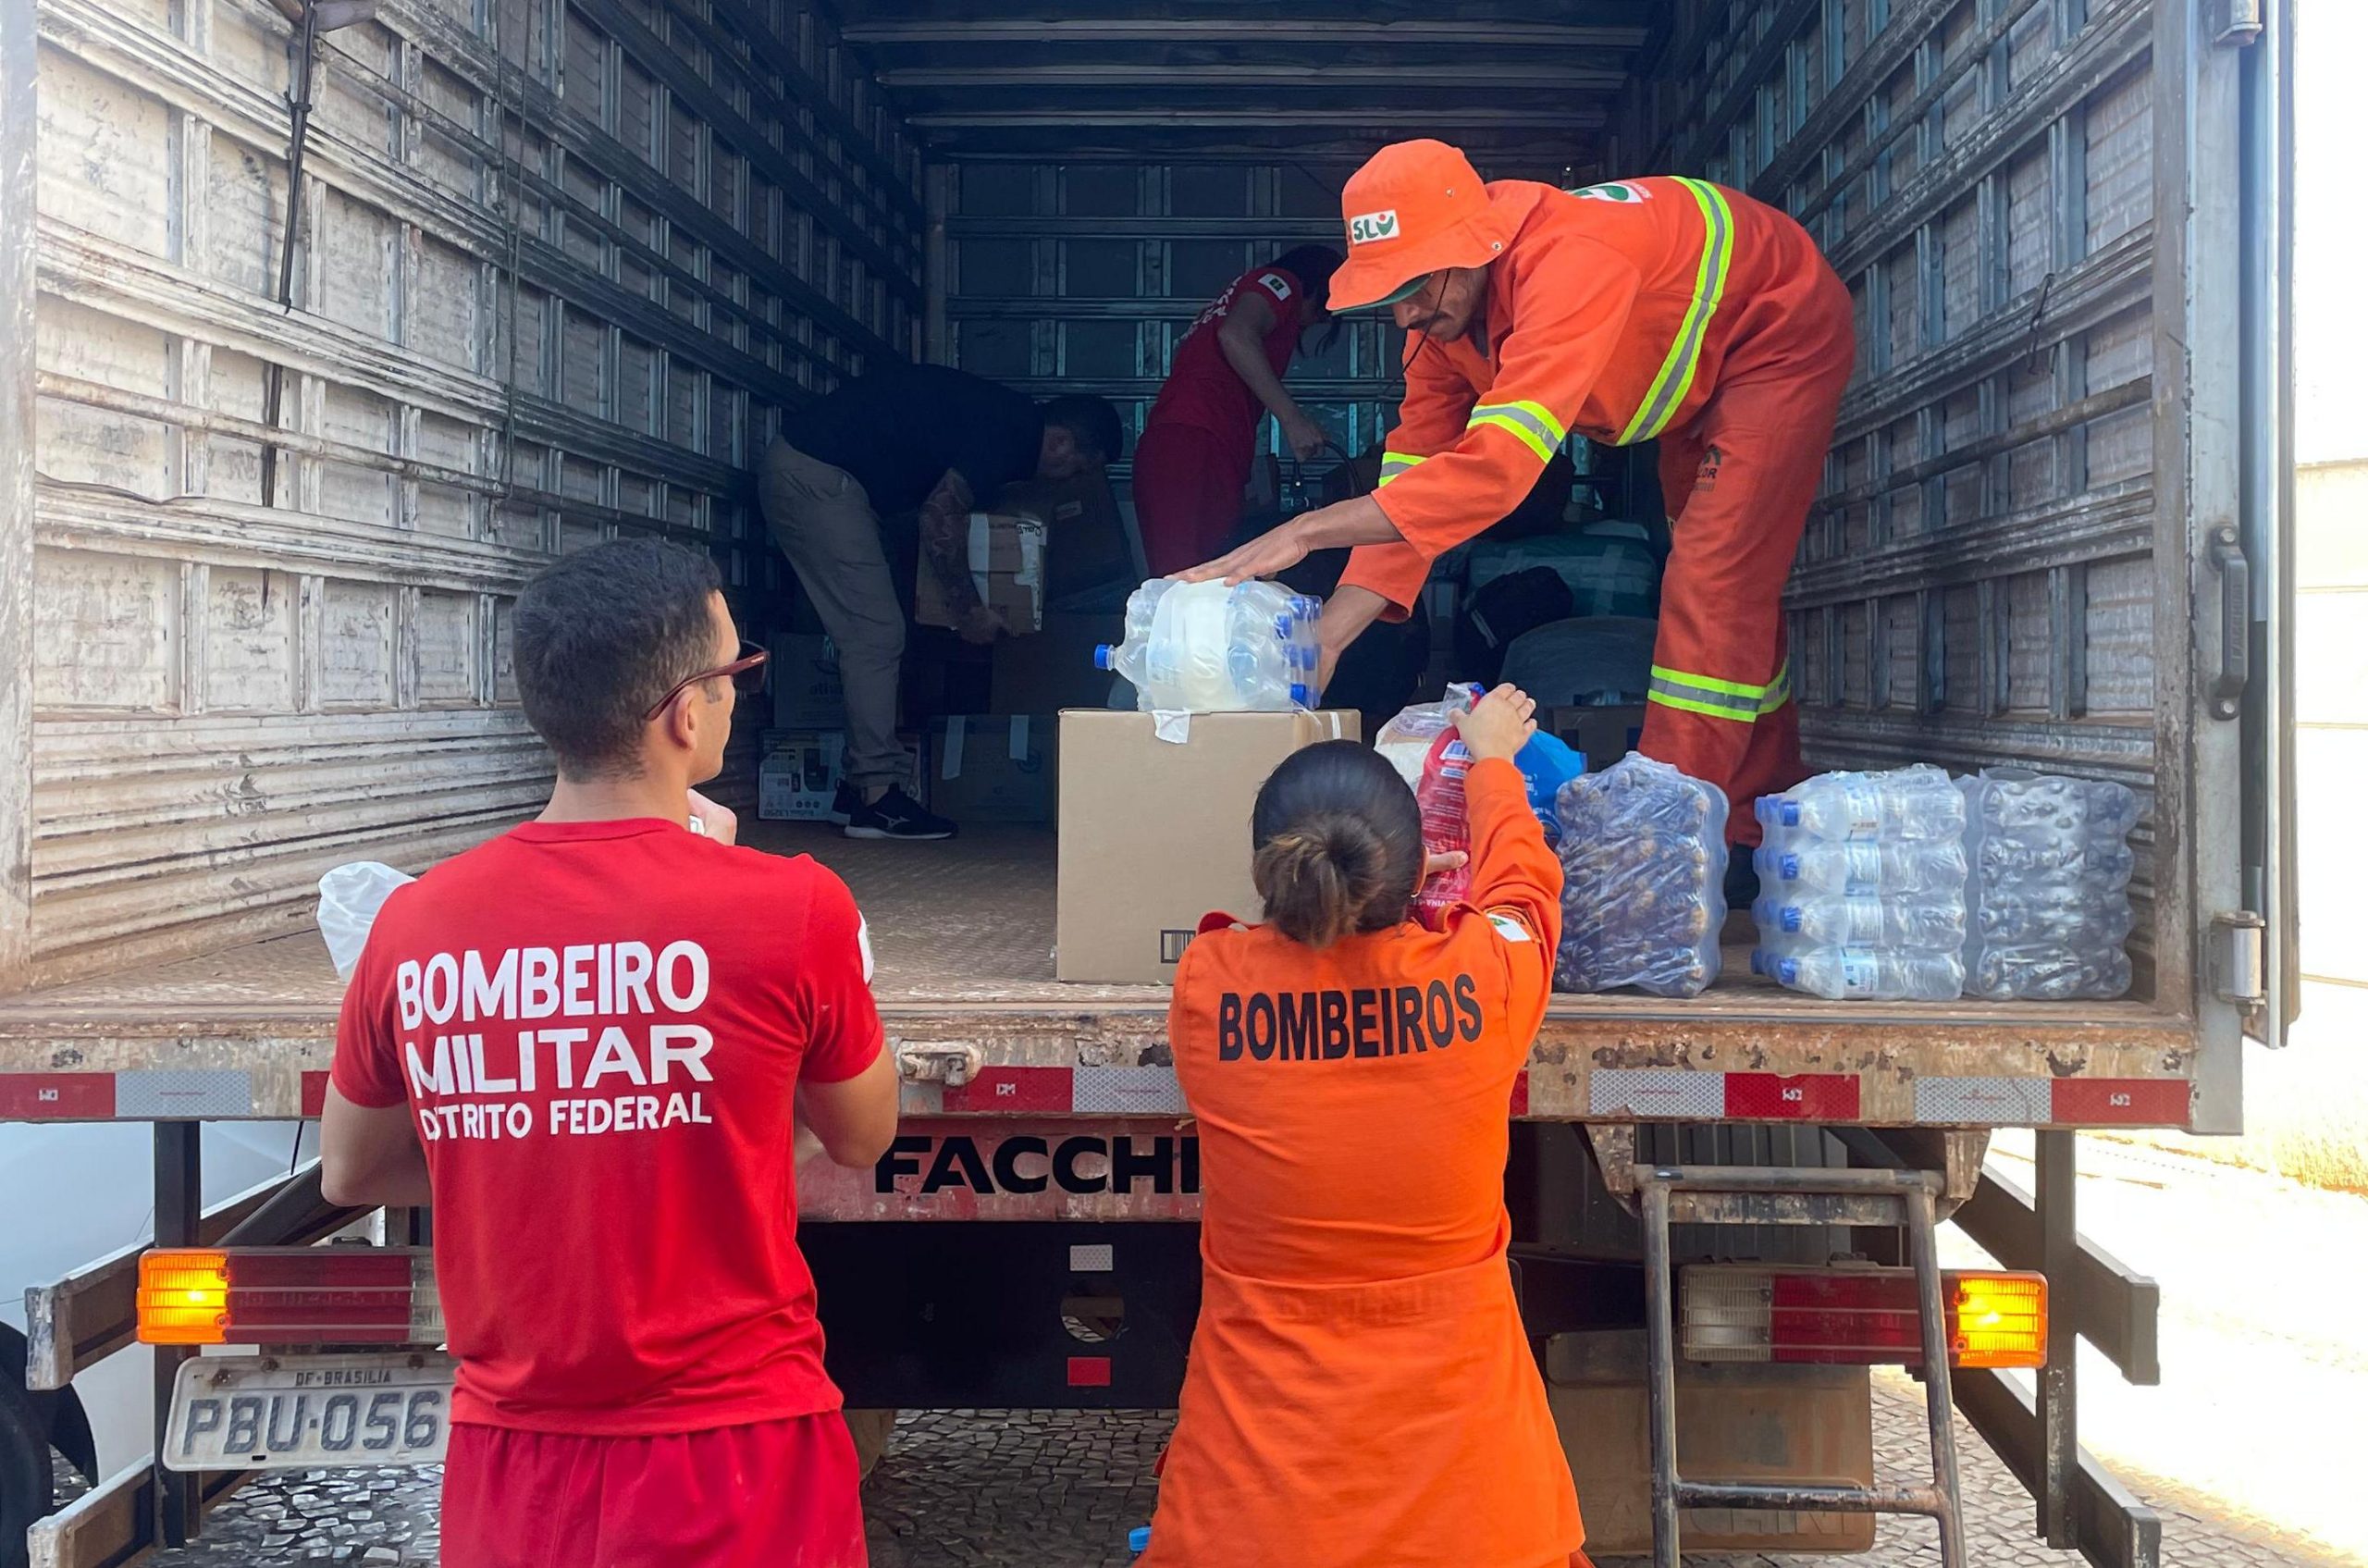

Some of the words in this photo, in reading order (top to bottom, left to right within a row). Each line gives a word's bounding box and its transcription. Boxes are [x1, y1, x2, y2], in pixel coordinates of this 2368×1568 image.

[397, 940, 709, 1031] BOMBEIRO
[1219, 973, 1482, 1061] BOMBEIROS
[405, 1024, 714, 1099] MILITAR
[419, 1102, 533, 1141] DTRITO
[550, 1092, 712, 1135] FEDERAL
[875, 1136, 1200, 1194] FACCHI
